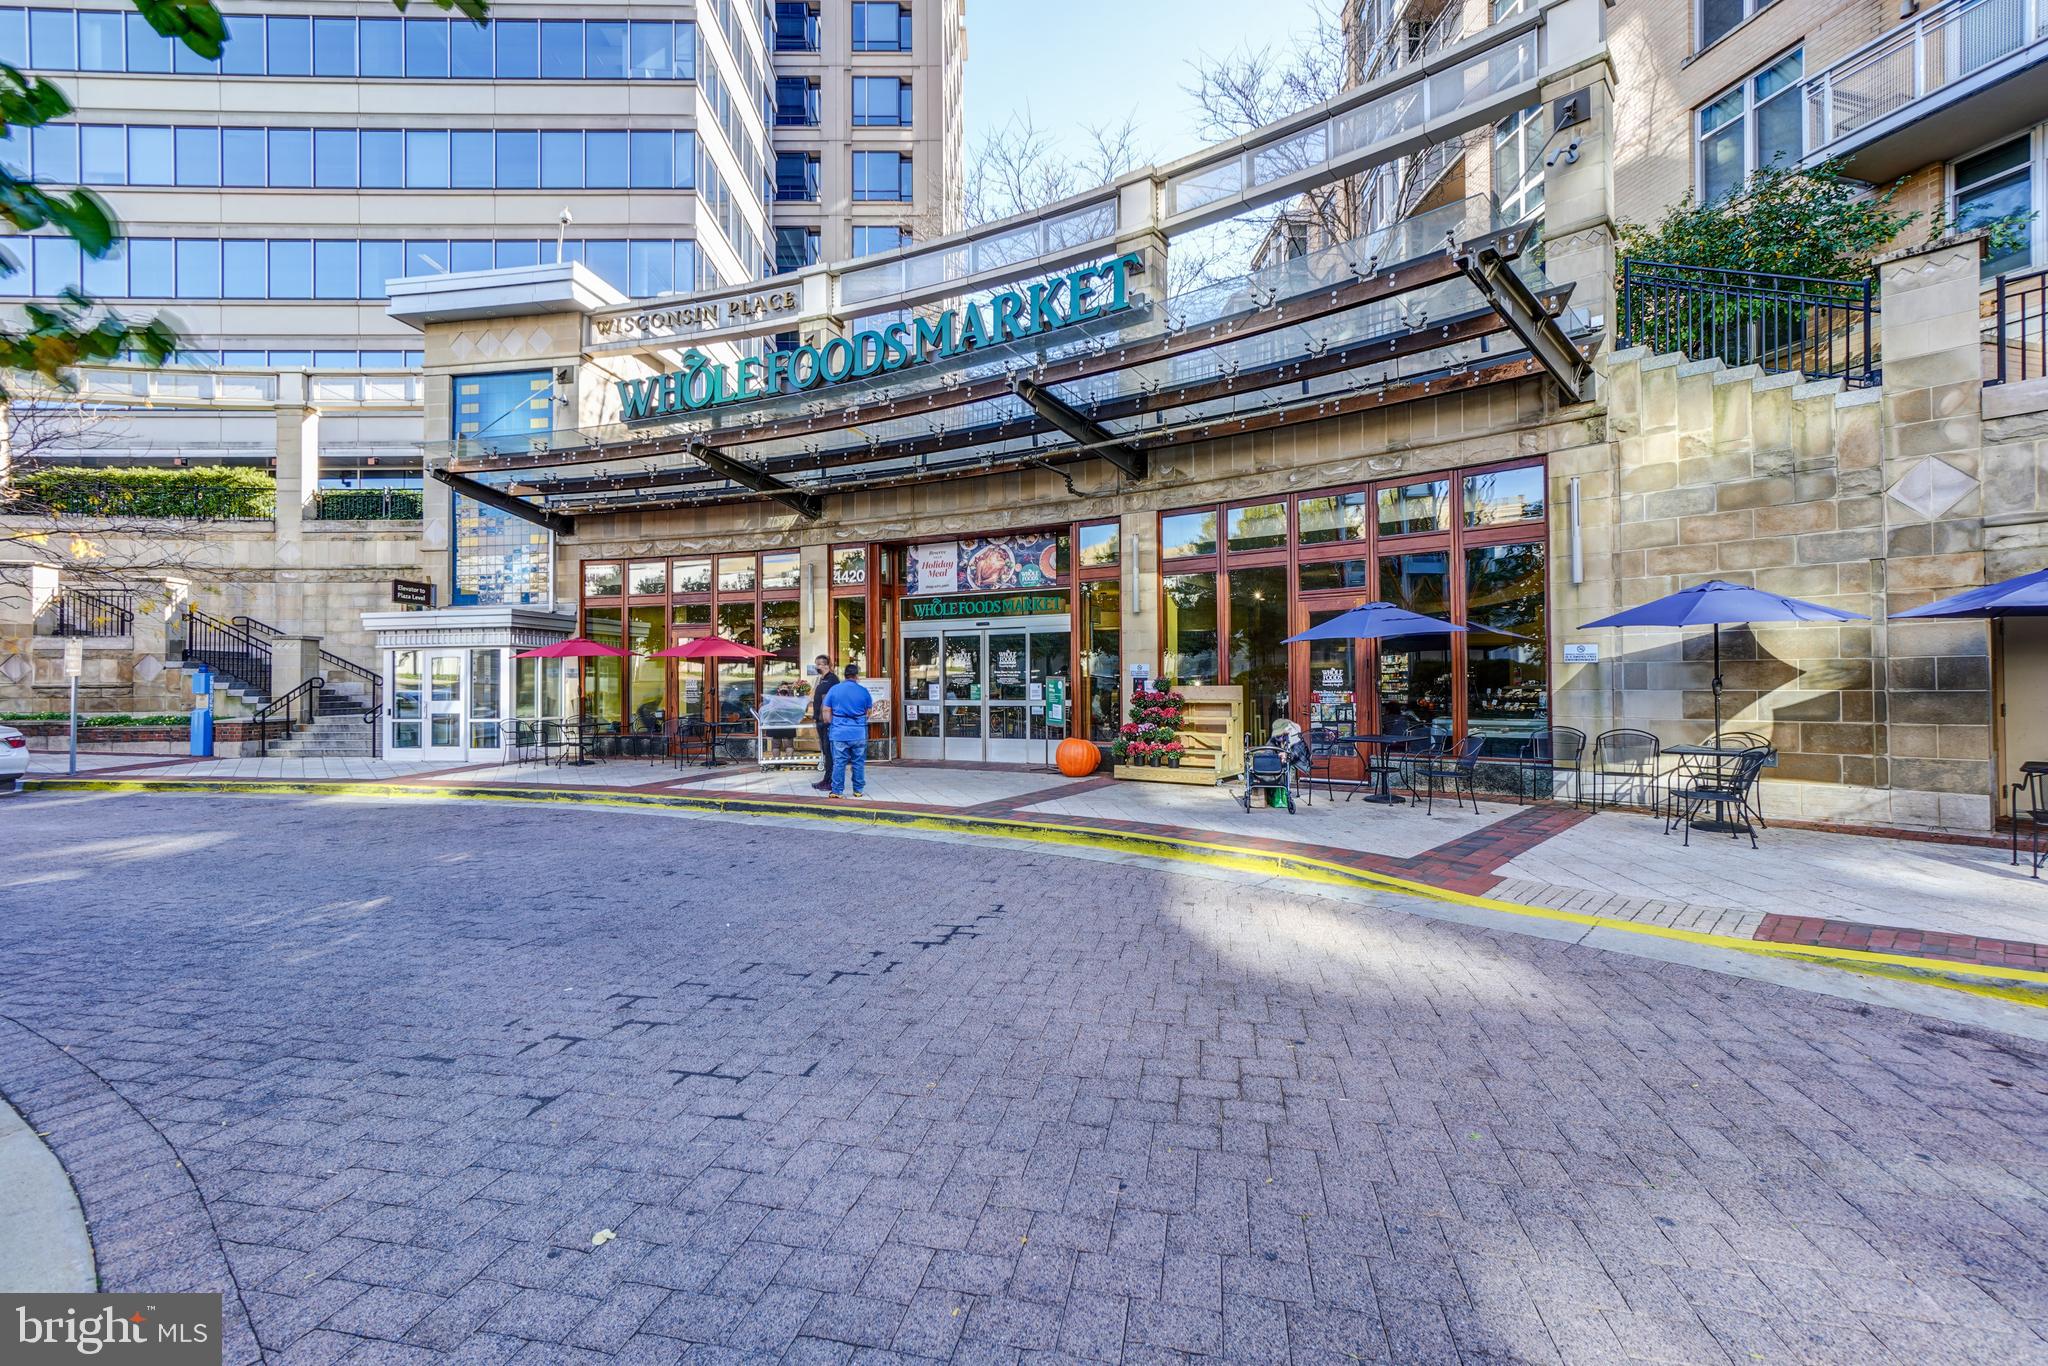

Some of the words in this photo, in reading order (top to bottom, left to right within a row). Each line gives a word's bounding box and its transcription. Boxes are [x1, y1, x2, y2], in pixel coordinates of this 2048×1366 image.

[597, 305, 718, 336] WISCONSIN
[728, 291, 796, 318] PLACE
[615, 349, 760, 419] WHOLE
[766, 322, 911, 395] FOODS
[913, 252, 1144, 364] MARKET
[921, 560, 954, 570] Holiday
[833, 569, 865, 584] 4420
[928, 569, 948, 578] Meal
[397, 584, 419, 594] Elevator
[397, 592, 411, 600] Plaza
[913, 598, 957, 617] WHOLE
[958, 600, 1000, 615] FOODS
[1001, 597, 1060, 612] MARKET
[1321, 668, 1343, 676] WHOLE
